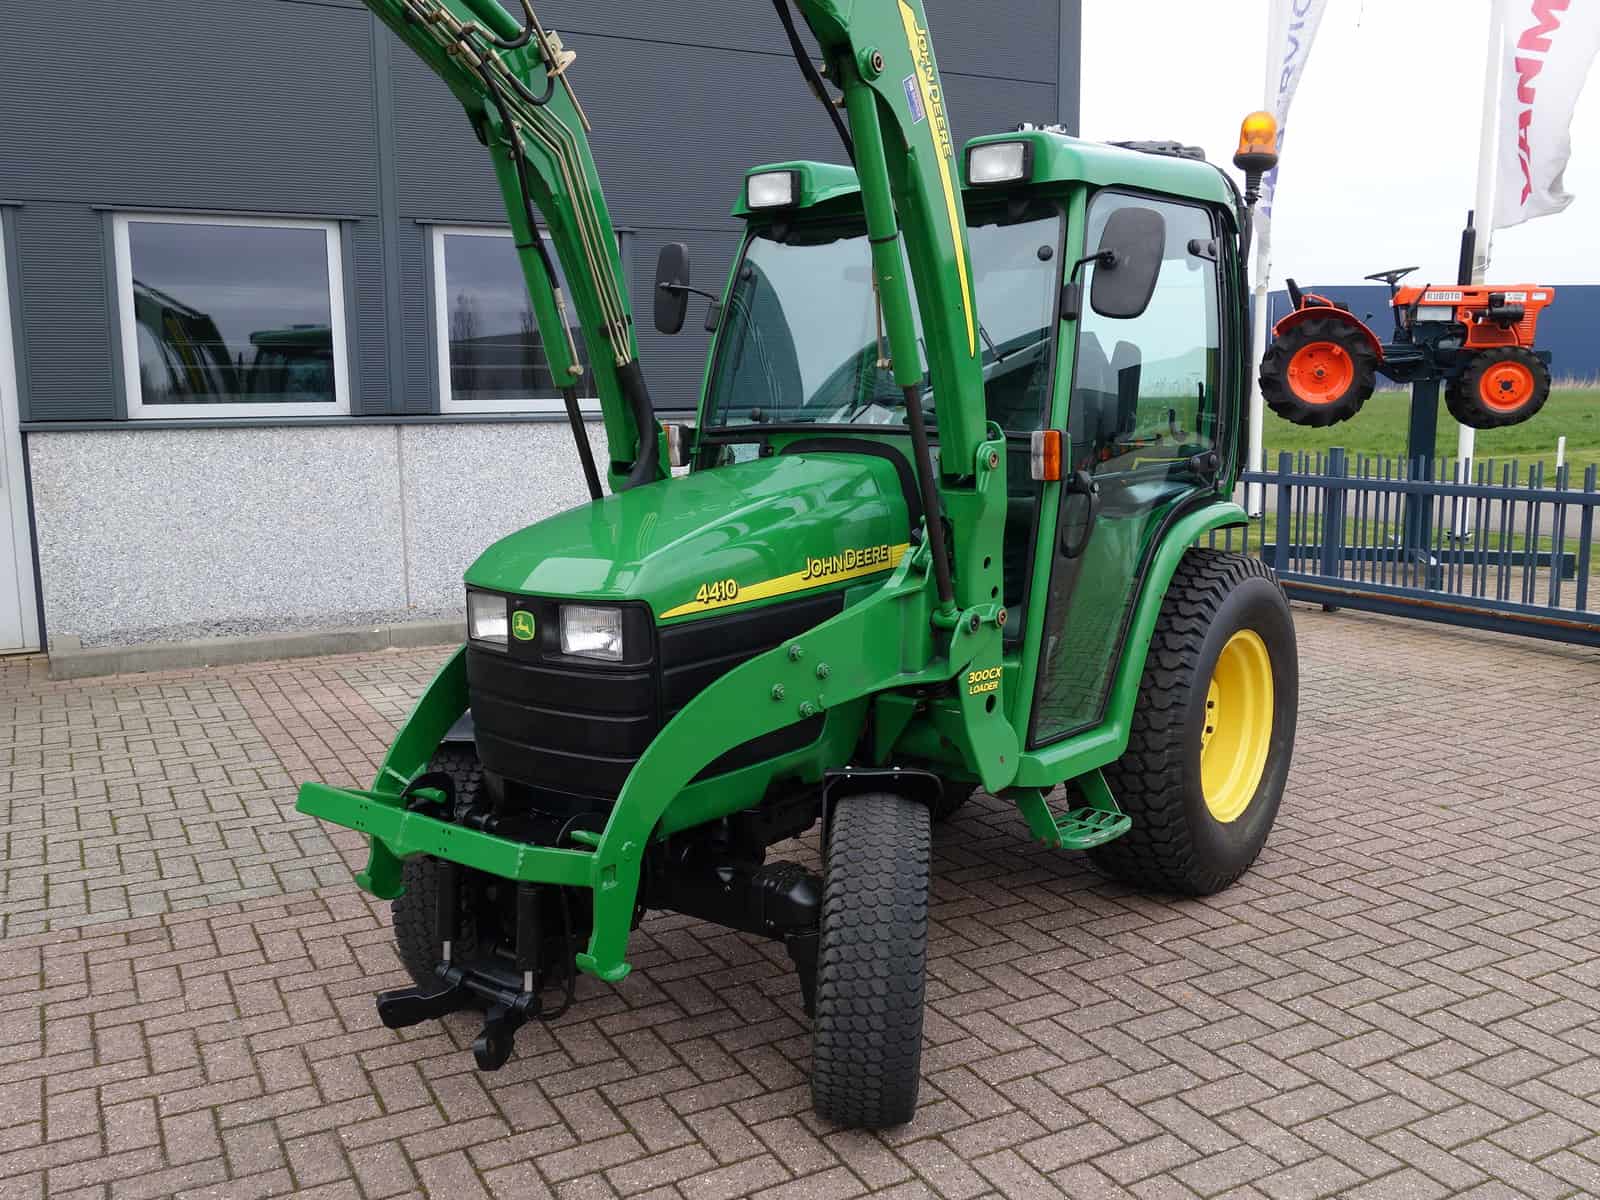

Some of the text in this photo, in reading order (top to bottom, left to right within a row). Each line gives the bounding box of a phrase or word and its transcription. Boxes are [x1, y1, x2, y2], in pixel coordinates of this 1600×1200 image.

[913, 21, 935, 82] JOHN
[928, 83, 952, 158] DEERE
[1427, 292, 1461, 300] KUBOTA
[802, 545, 889, 580] JOHN DEERE
[696, 578, 737, 603] 4410
[968, 666, 1002, 684] 300CX
[969, 681, 999, 695] LOADER
